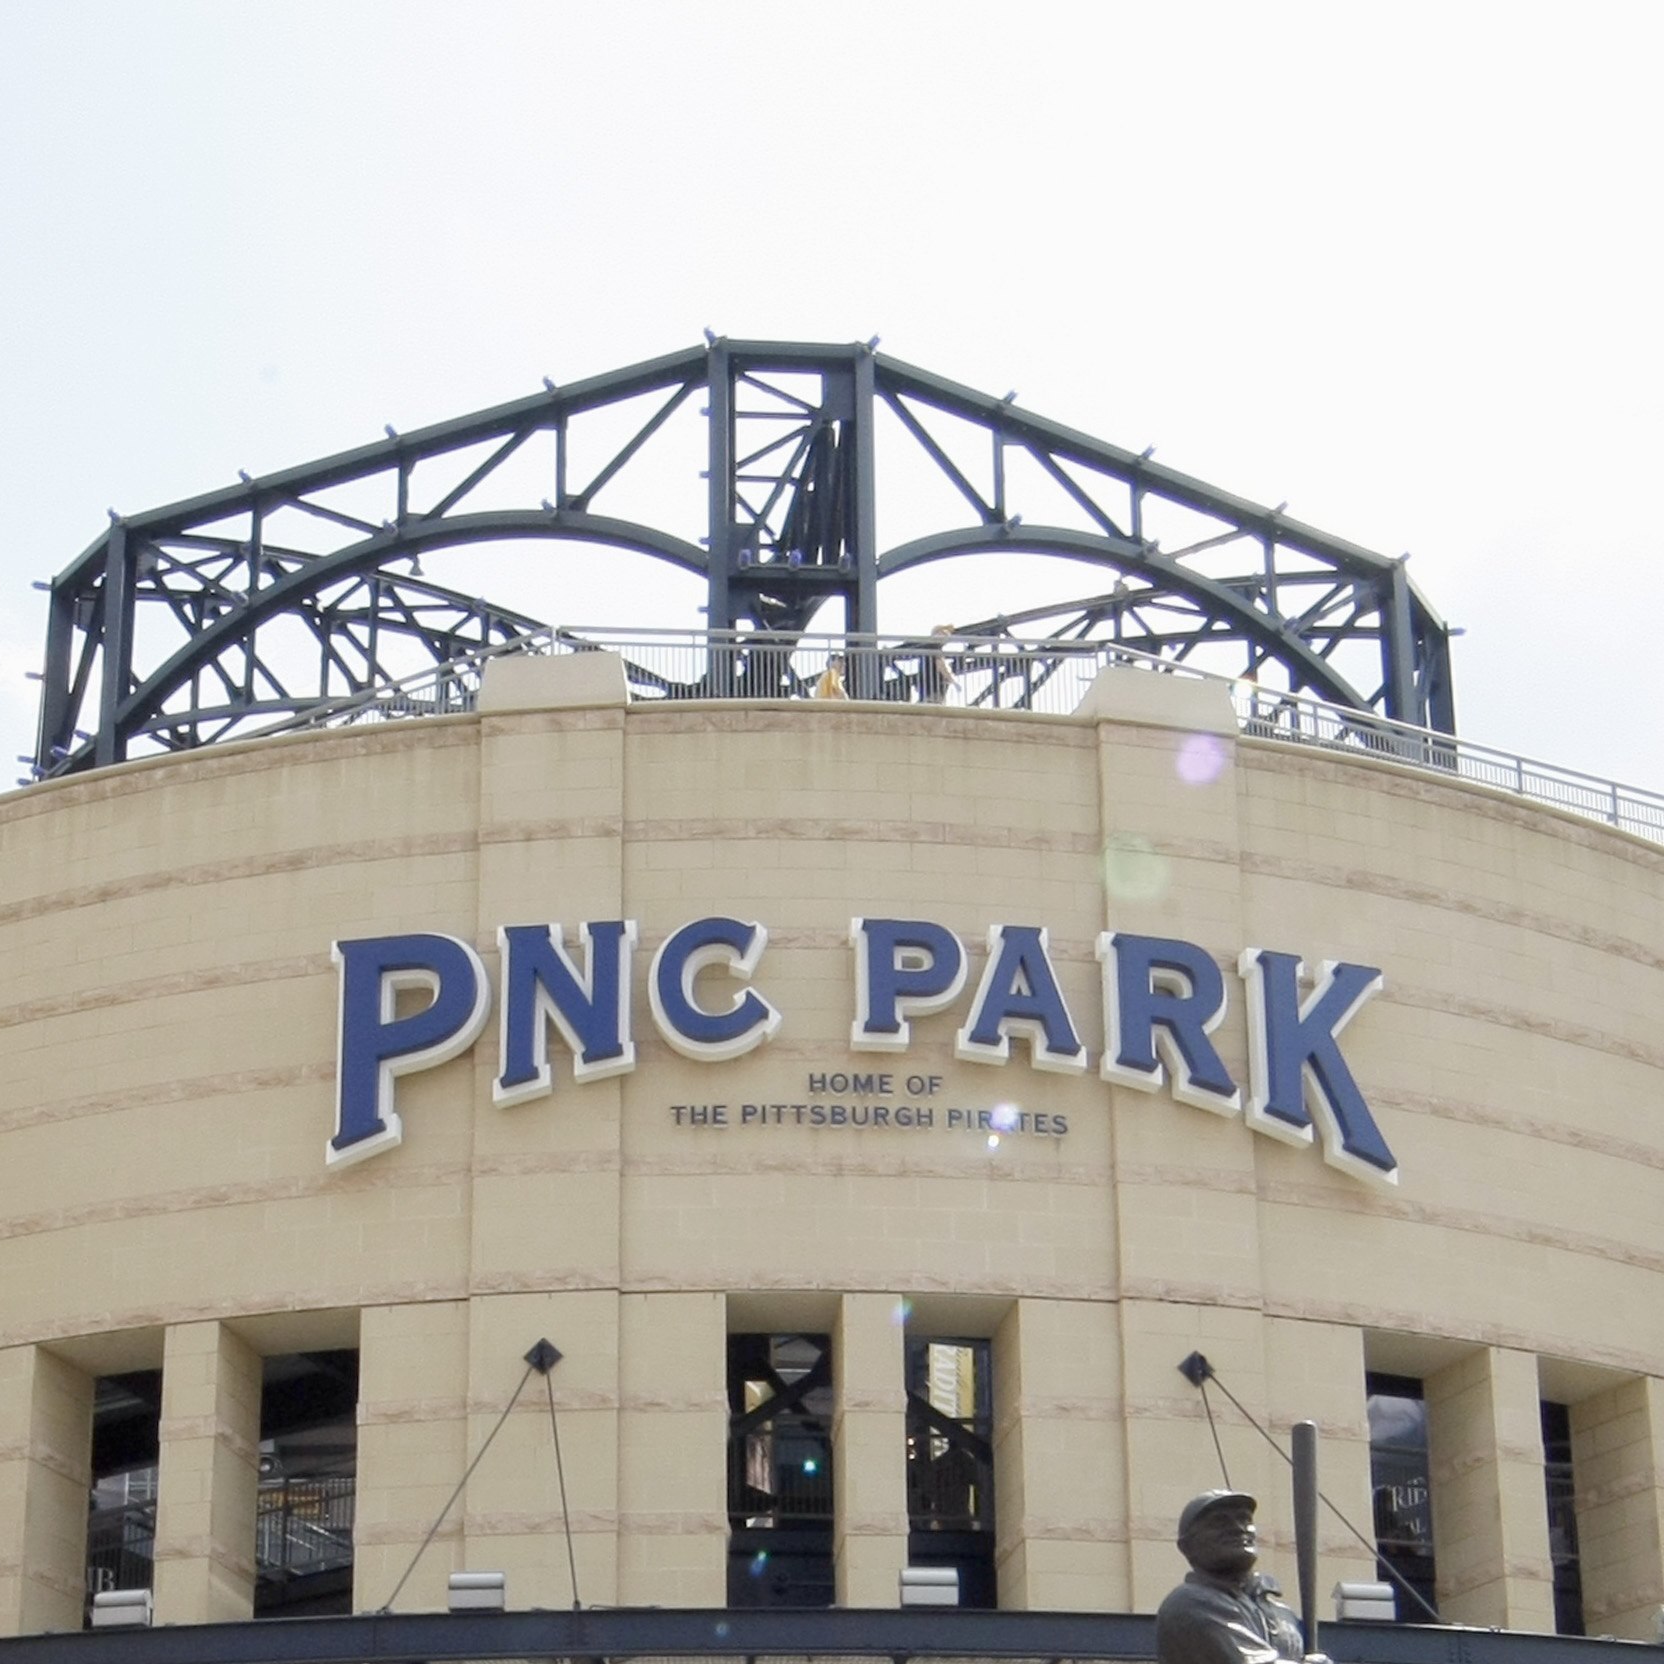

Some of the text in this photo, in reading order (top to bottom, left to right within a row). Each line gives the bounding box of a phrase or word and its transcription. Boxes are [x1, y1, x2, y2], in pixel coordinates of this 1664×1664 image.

[325, 916, 1398, 1187] PNC PARK
[808, 1072, 944, 1096] HOME OF
[671, 1105, 728, 1126] THE
[741, 1104, 934, 1128] PITTSBURGH
